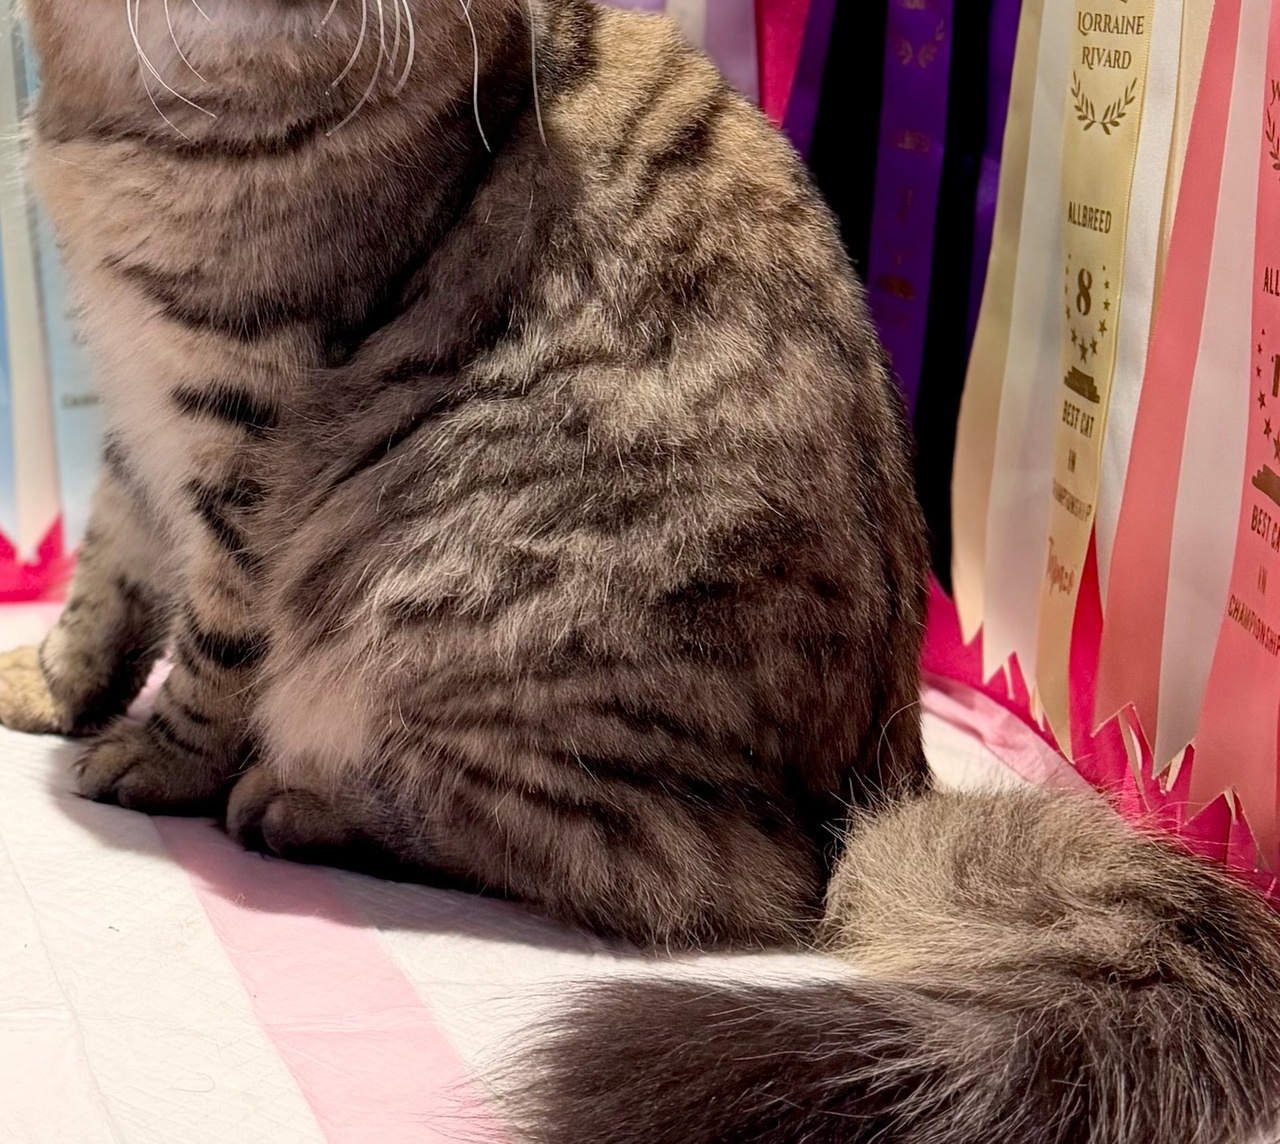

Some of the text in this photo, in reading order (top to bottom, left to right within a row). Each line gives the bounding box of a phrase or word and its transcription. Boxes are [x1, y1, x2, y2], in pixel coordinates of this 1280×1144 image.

[1077, 11, 1144, 36] LORRAINE
[1081, 46, 1132, 70] RIVARD
[1068, 201, 1112, 234] ALLBREED
[1076, 268, 1092, 316] 8
[1062, 400, 1095, 440] BEST CAT
[1251, 504, 1271, 540] BEST
